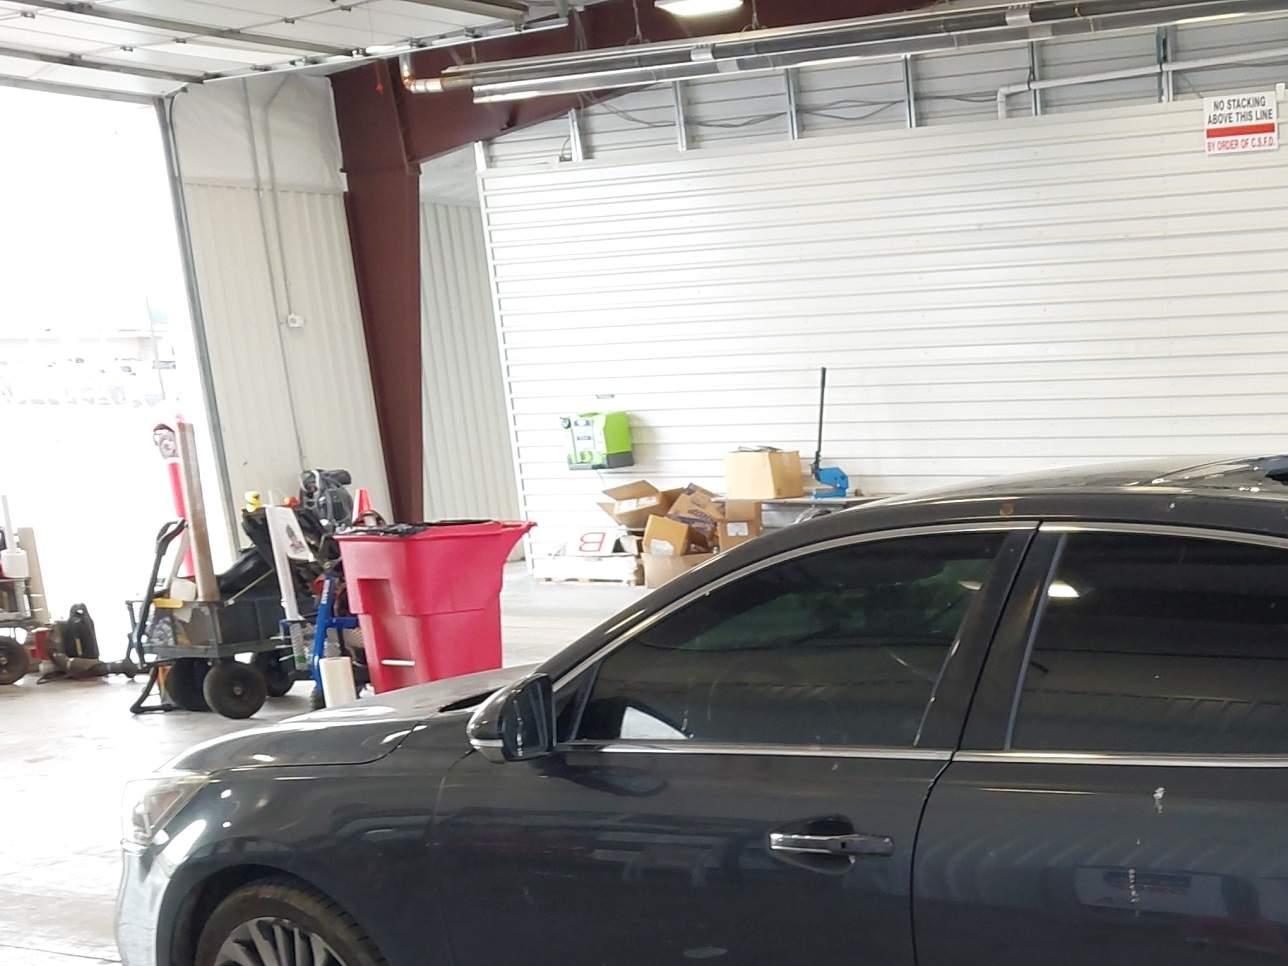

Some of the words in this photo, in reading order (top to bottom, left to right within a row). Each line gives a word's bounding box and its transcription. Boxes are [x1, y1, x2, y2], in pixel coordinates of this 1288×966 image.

[1213, 100, 1225, 111] NO
[1227, 96, 1266, 110] STACKING
[1208, 112, 1233, 125] ABOVE
[1235, 110, 1253, 122] THIS
[1255, 108, 1273, 120] LINE
[1207, 141, 1216, 152] BY
[1217, 138, 1239, 150] ORDER
[1240, 138, 1249, 149] OF
